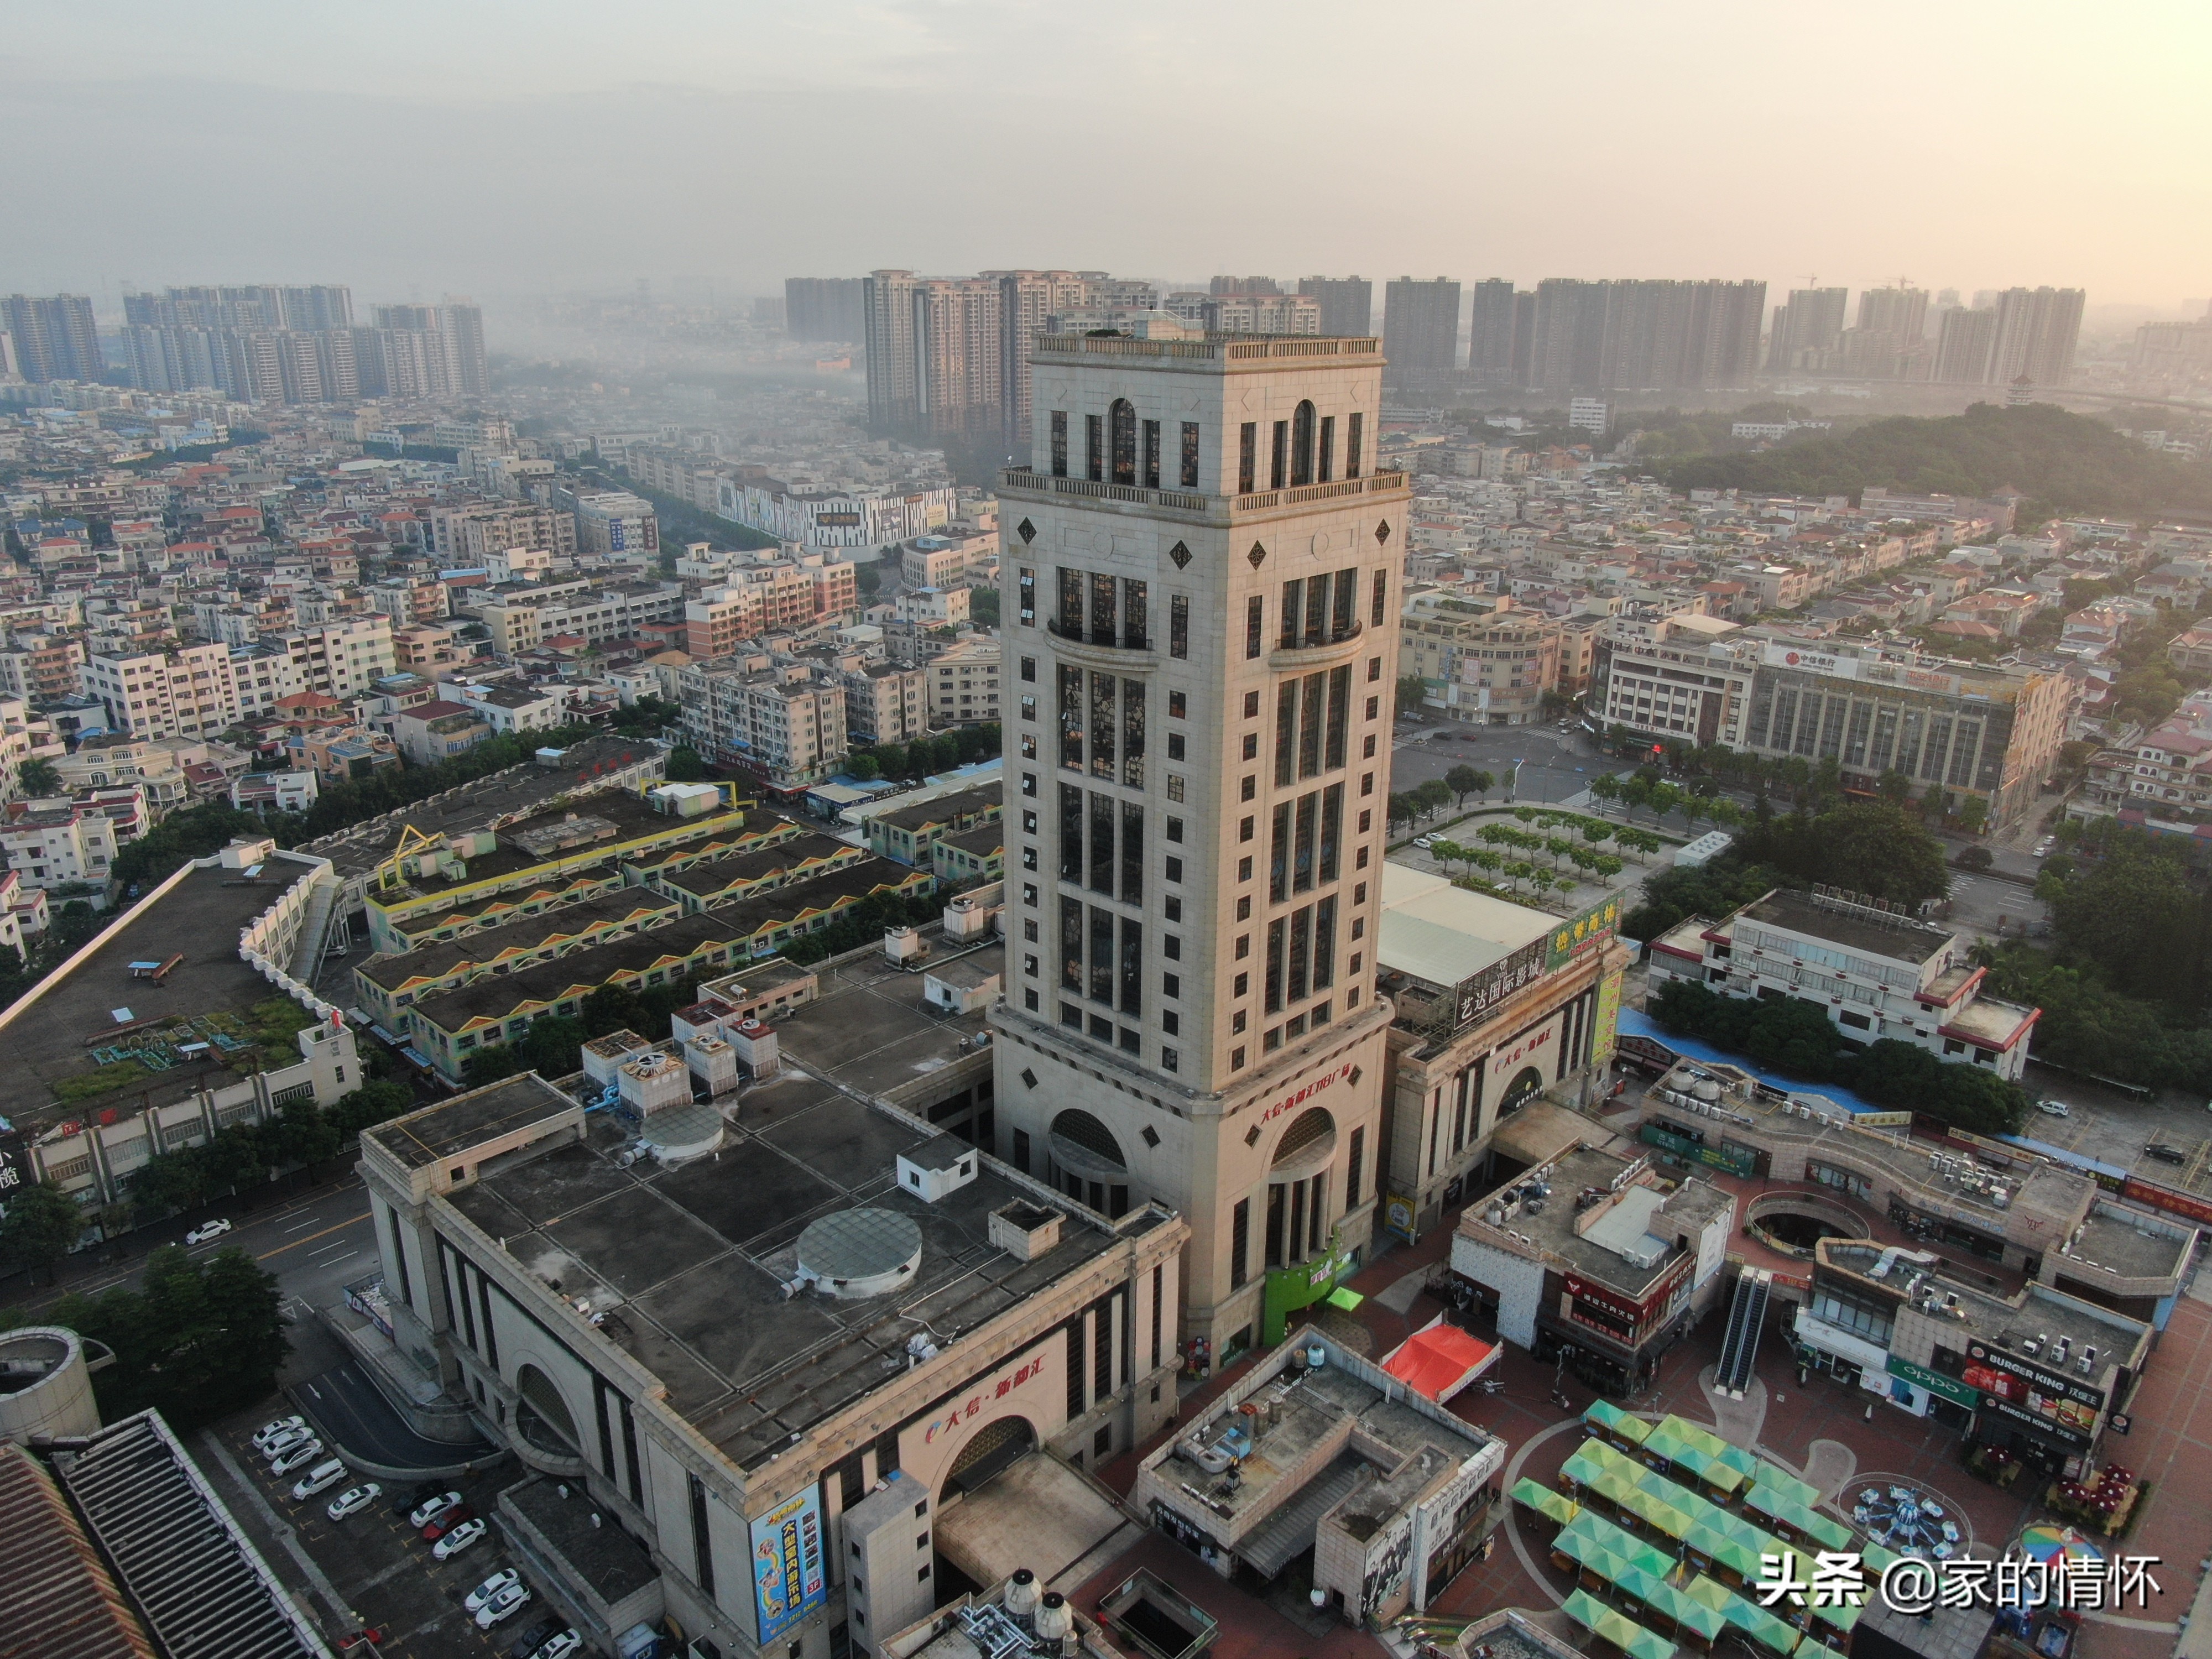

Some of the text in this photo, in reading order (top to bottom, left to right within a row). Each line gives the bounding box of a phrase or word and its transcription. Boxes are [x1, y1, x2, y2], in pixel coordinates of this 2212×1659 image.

[1801, 654, 1835, 667] 中信银行
[1461, 957, 1540, 1019] 艺达国际影城
[1604, 975, 1620, 1052] 潮州美食馆
[945, 1354, 1046, 1434] 大信·新都汇
[1990, 1354, 2098, 1405] BURGER KING 汉堡王
[1999, 1404, 2031, 1423] BURGER
[2032, 1418, 2053, 1432] KING
[783, 1522, 801, 1609] 大型室内游乐场
[809, 1581, 819, 1593] 3F
